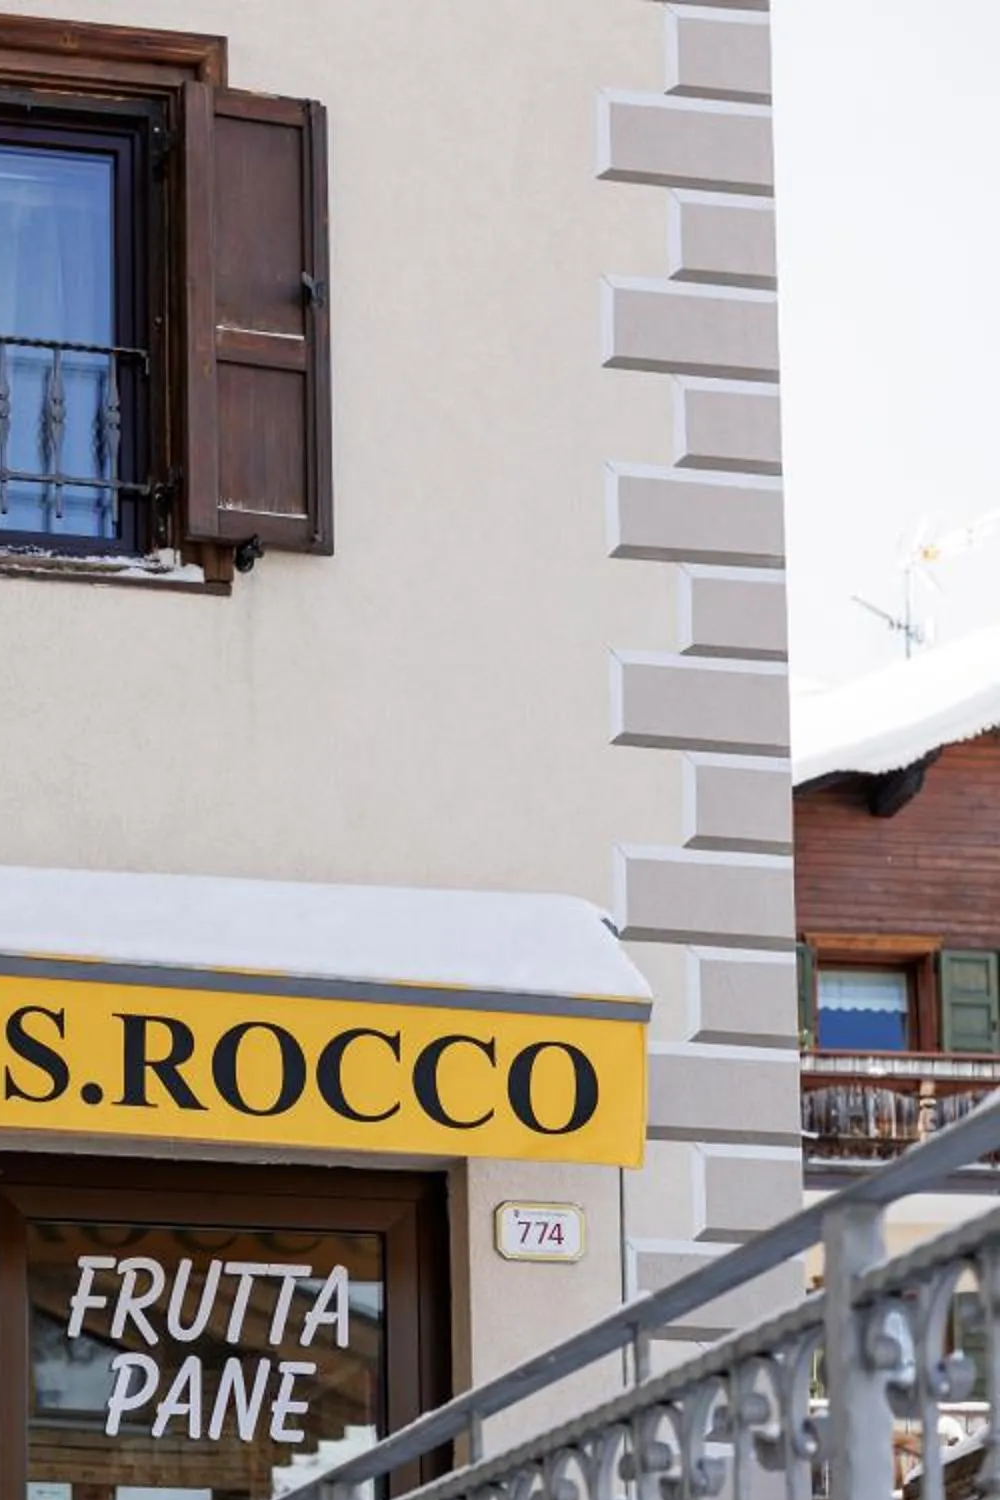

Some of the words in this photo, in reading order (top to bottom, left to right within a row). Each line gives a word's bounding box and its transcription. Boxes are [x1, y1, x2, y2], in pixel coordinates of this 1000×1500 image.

[4, 1005, 600, 1135] S.ROCCO
[517, 1221, 565, 1245] 774
[66, 1255, 351, 1349] FRUTTA
[104, 1352, 318, 1444] PANE
